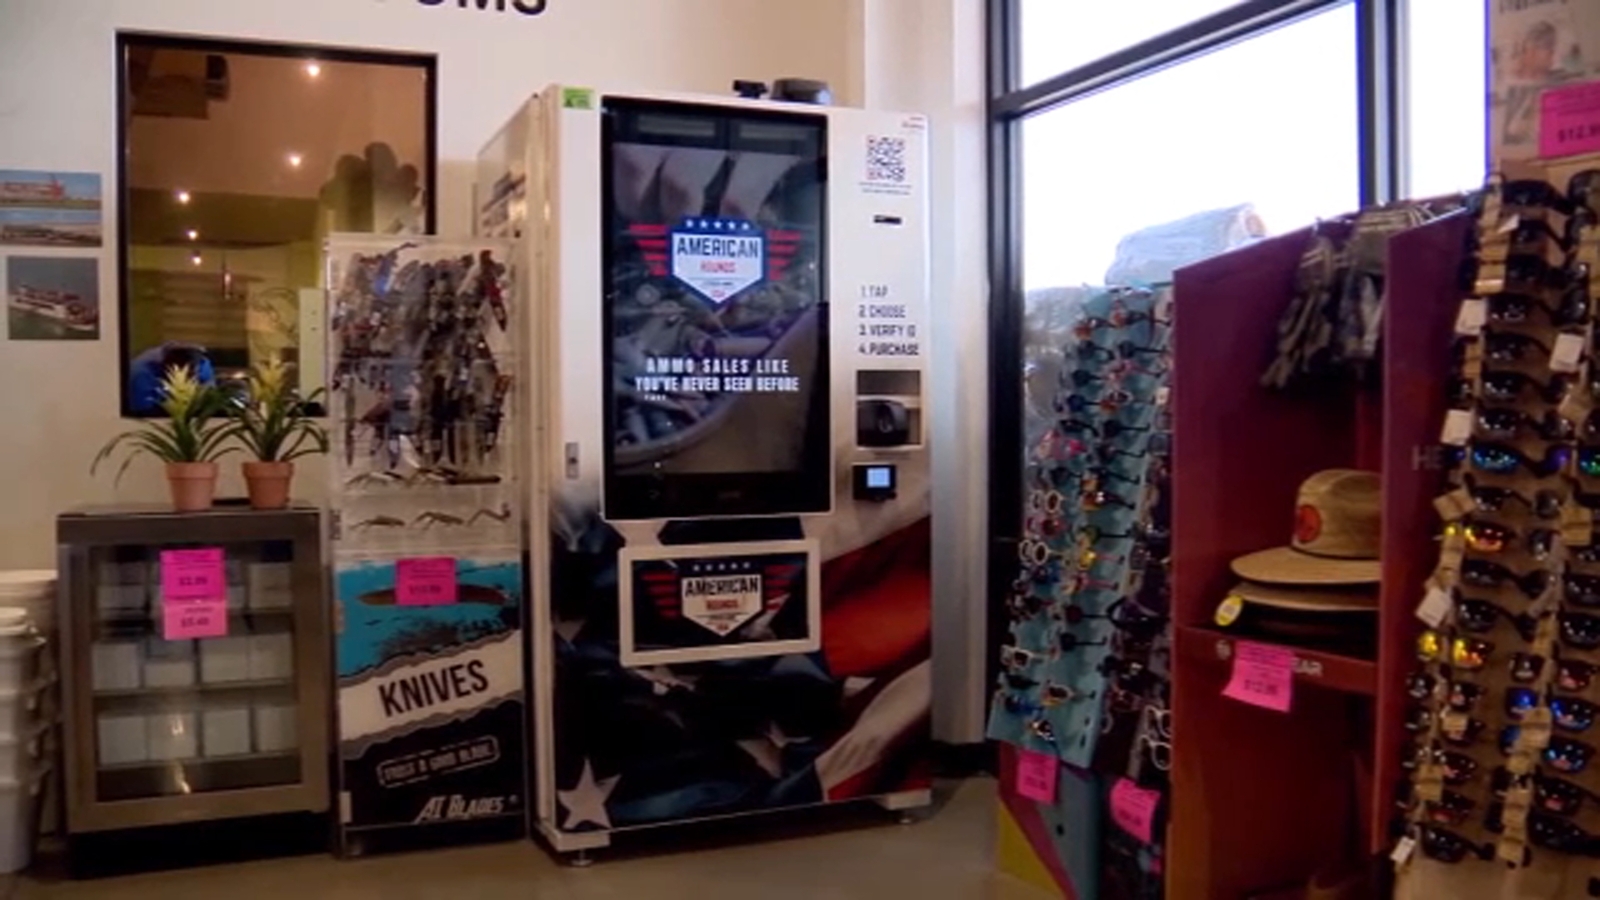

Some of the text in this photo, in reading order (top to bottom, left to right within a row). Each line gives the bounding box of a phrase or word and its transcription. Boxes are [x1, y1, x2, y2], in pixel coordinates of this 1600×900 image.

[676, 238, 760, 258] AMERICAN
[869, 284, 888, 298] TAP
[869, 304, 906, 318] CHOOSE
[869, 323, 904, 336] VERIFY
[869, 342, 919, 355] PURCHASE
[645, 357, 789, 374] AMMO SALES LIKE
[634, 376, 800, 392] YOU'VE NEVER SEEN BEFORE
[685, 577, 759, 597] AMERICAN
[378, 659, 489, 718] KNIVES
